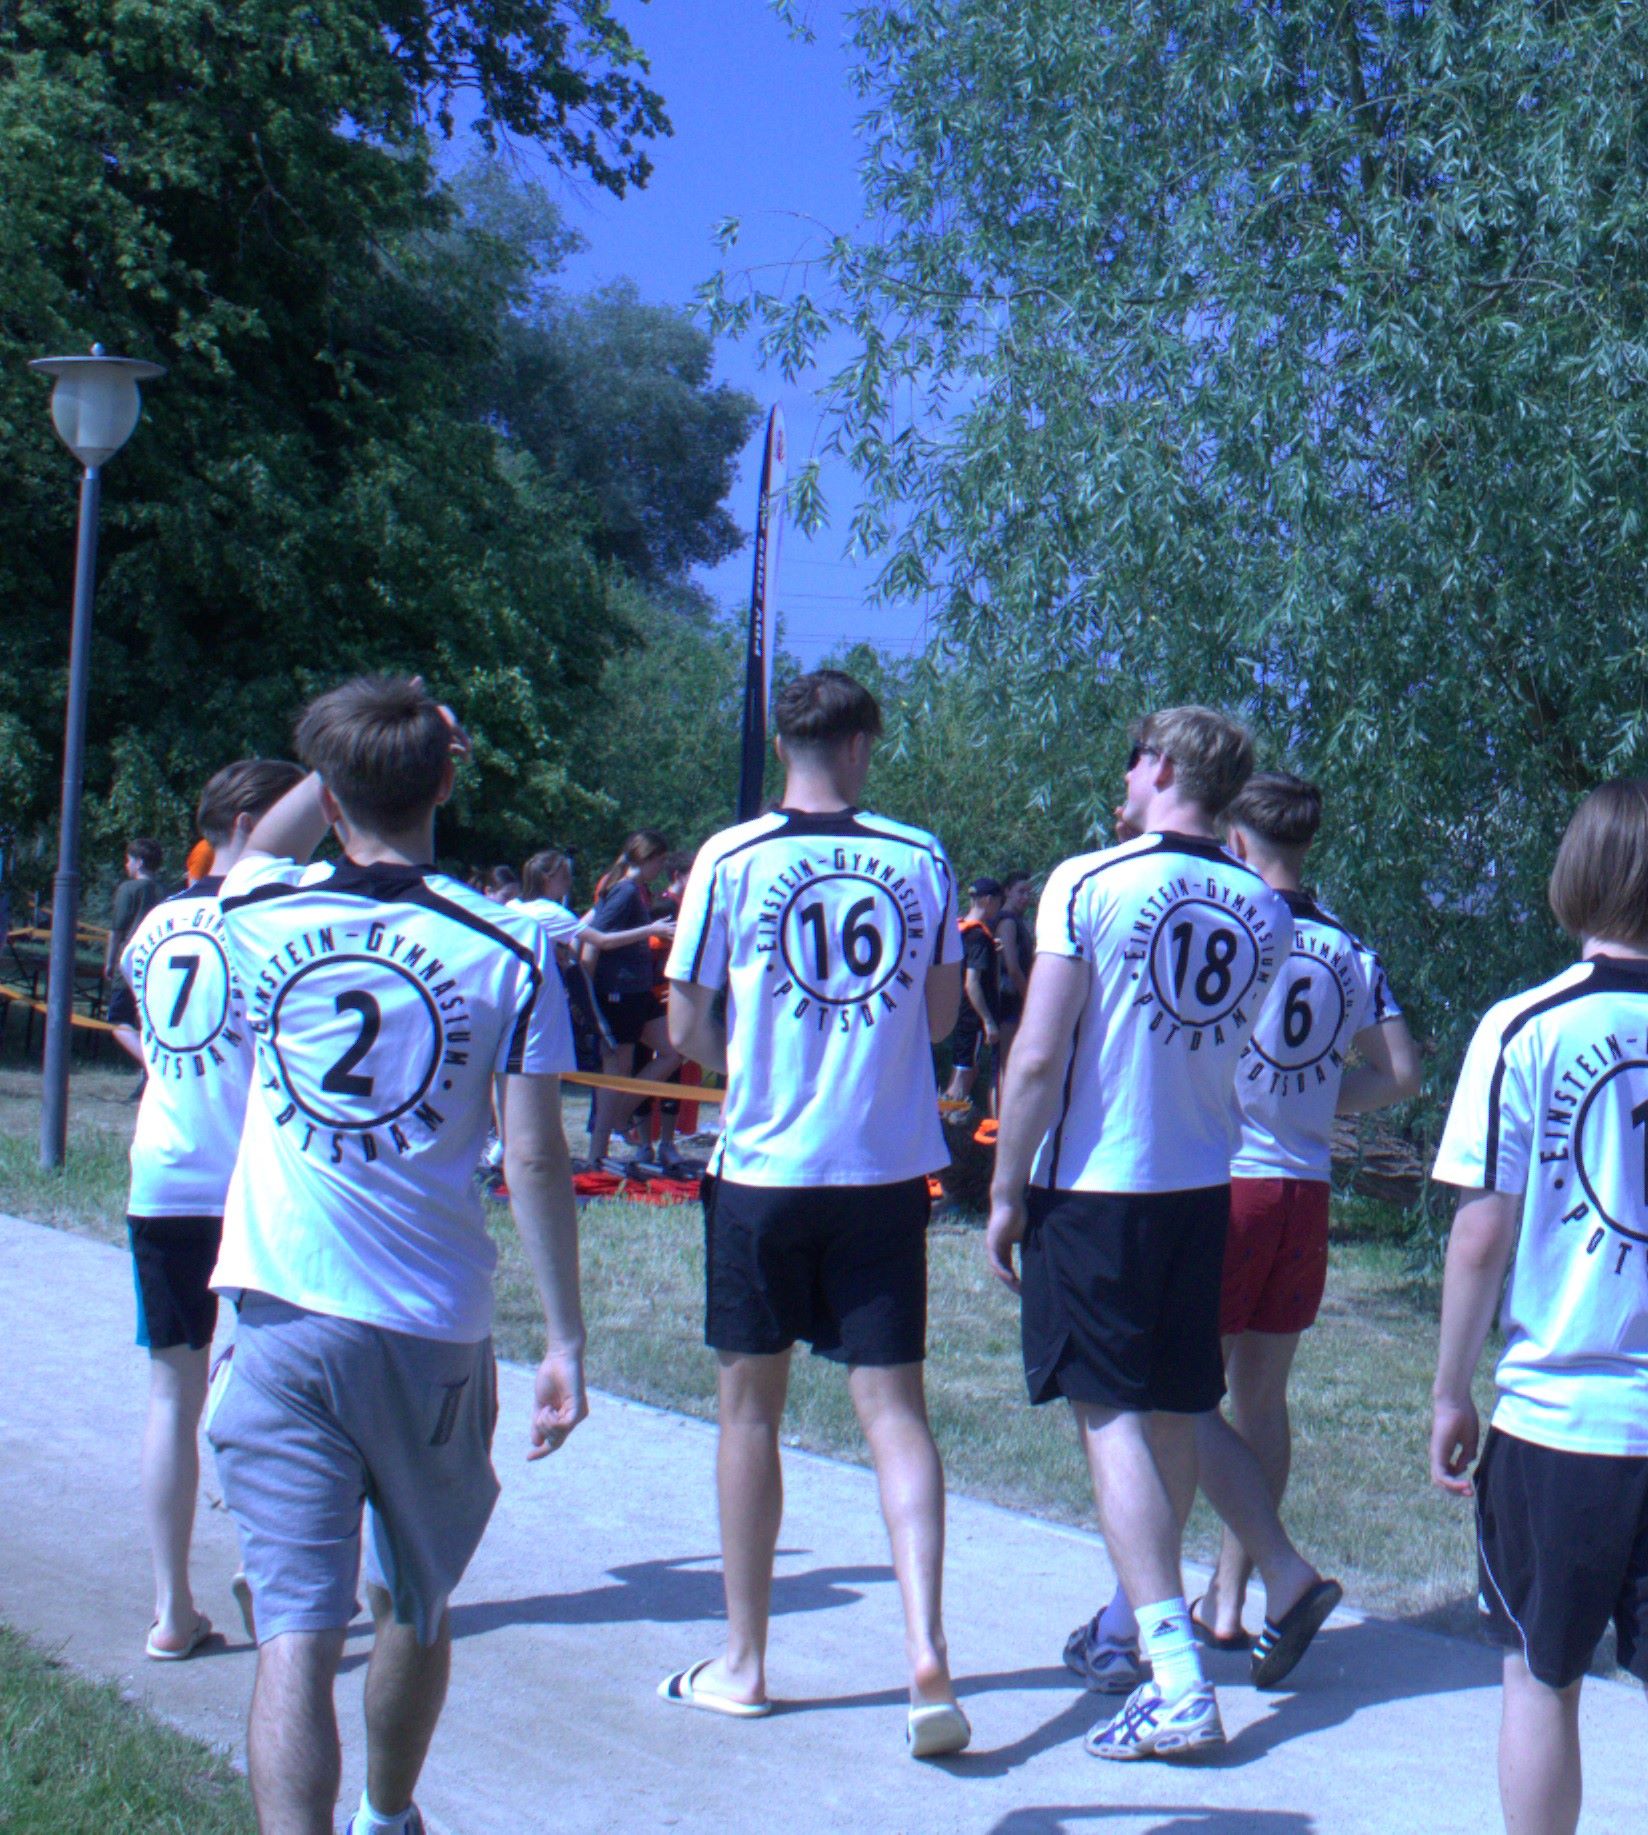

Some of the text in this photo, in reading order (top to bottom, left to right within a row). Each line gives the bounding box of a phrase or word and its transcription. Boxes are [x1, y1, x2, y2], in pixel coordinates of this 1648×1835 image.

[800, 897, 883, 981] 16
[1172, 920, 1238, 1006] 18
[169, 955, 201, 1028] 7
[772, 973, 914, 1032] POTSDAM
[1132, 992, 1248, 1051] POTDAM
[1284, 976, 1313, 1048] 6
[322, 990, 382, 1097] 2
